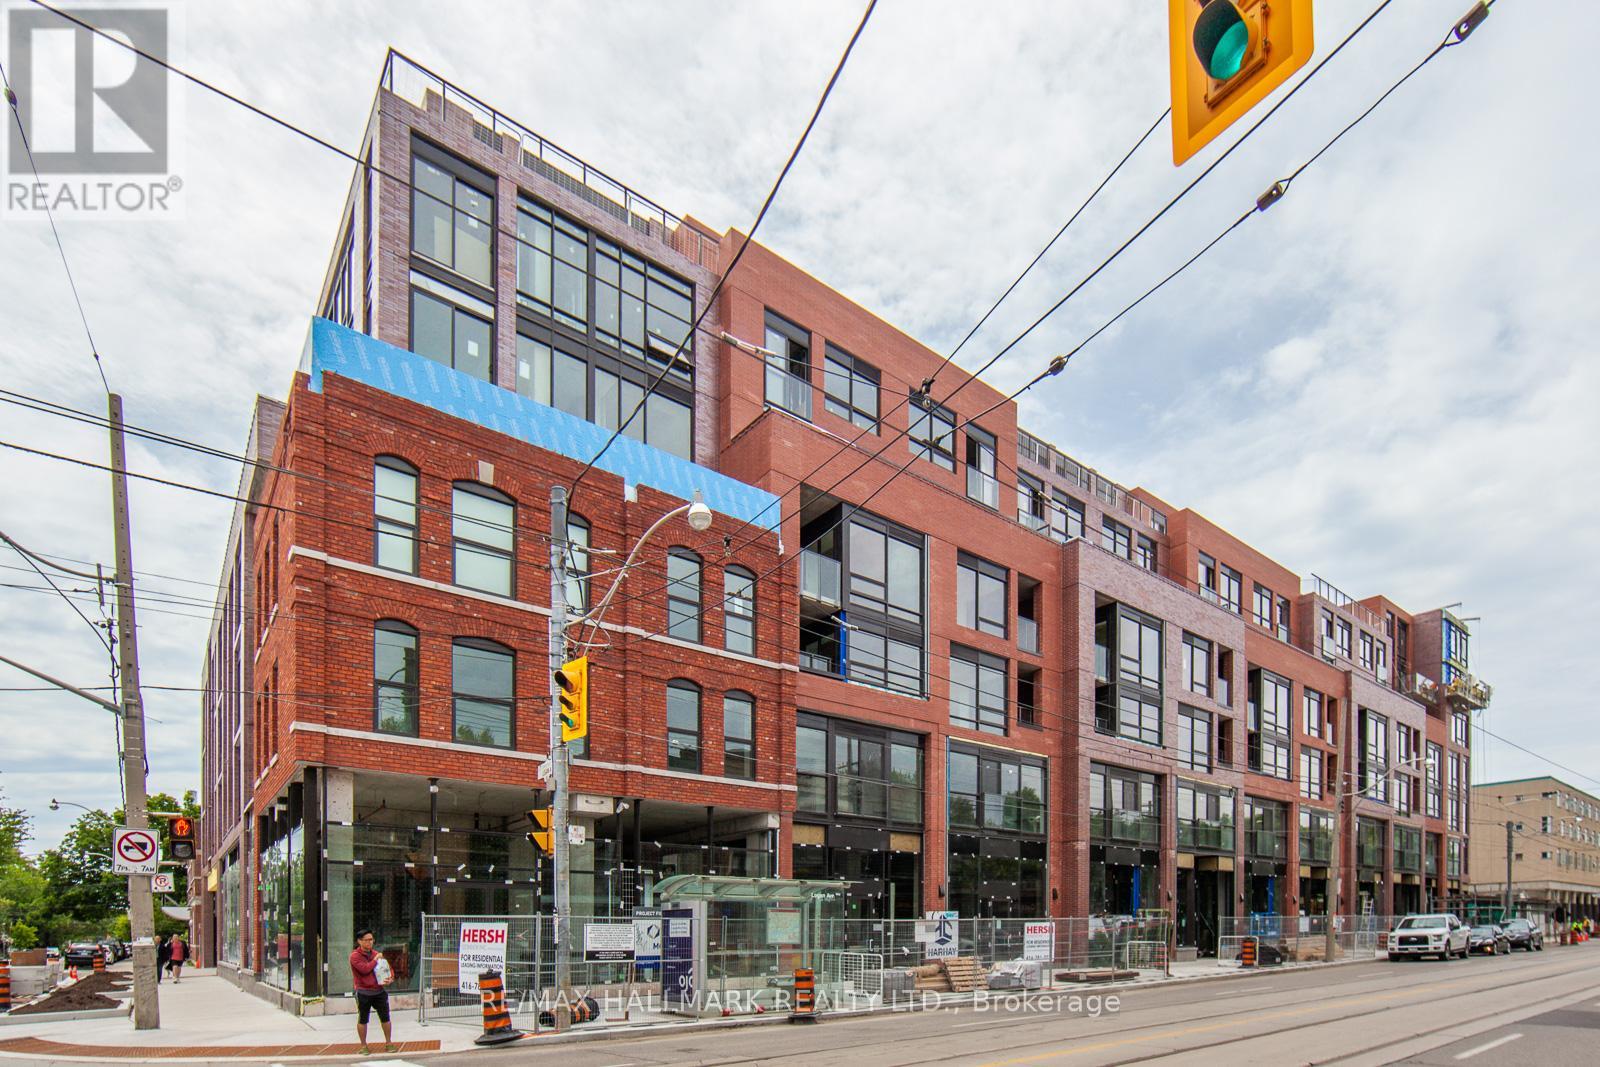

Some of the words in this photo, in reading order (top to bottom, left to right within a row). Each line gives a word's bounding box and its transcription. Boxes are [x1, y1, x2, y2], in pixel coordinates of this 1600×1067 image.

[462, 928, 505, 943] HERSH
[461, 954, 471, 962] FOR
[472, 954, 503, 963] RESIDENTIAL
